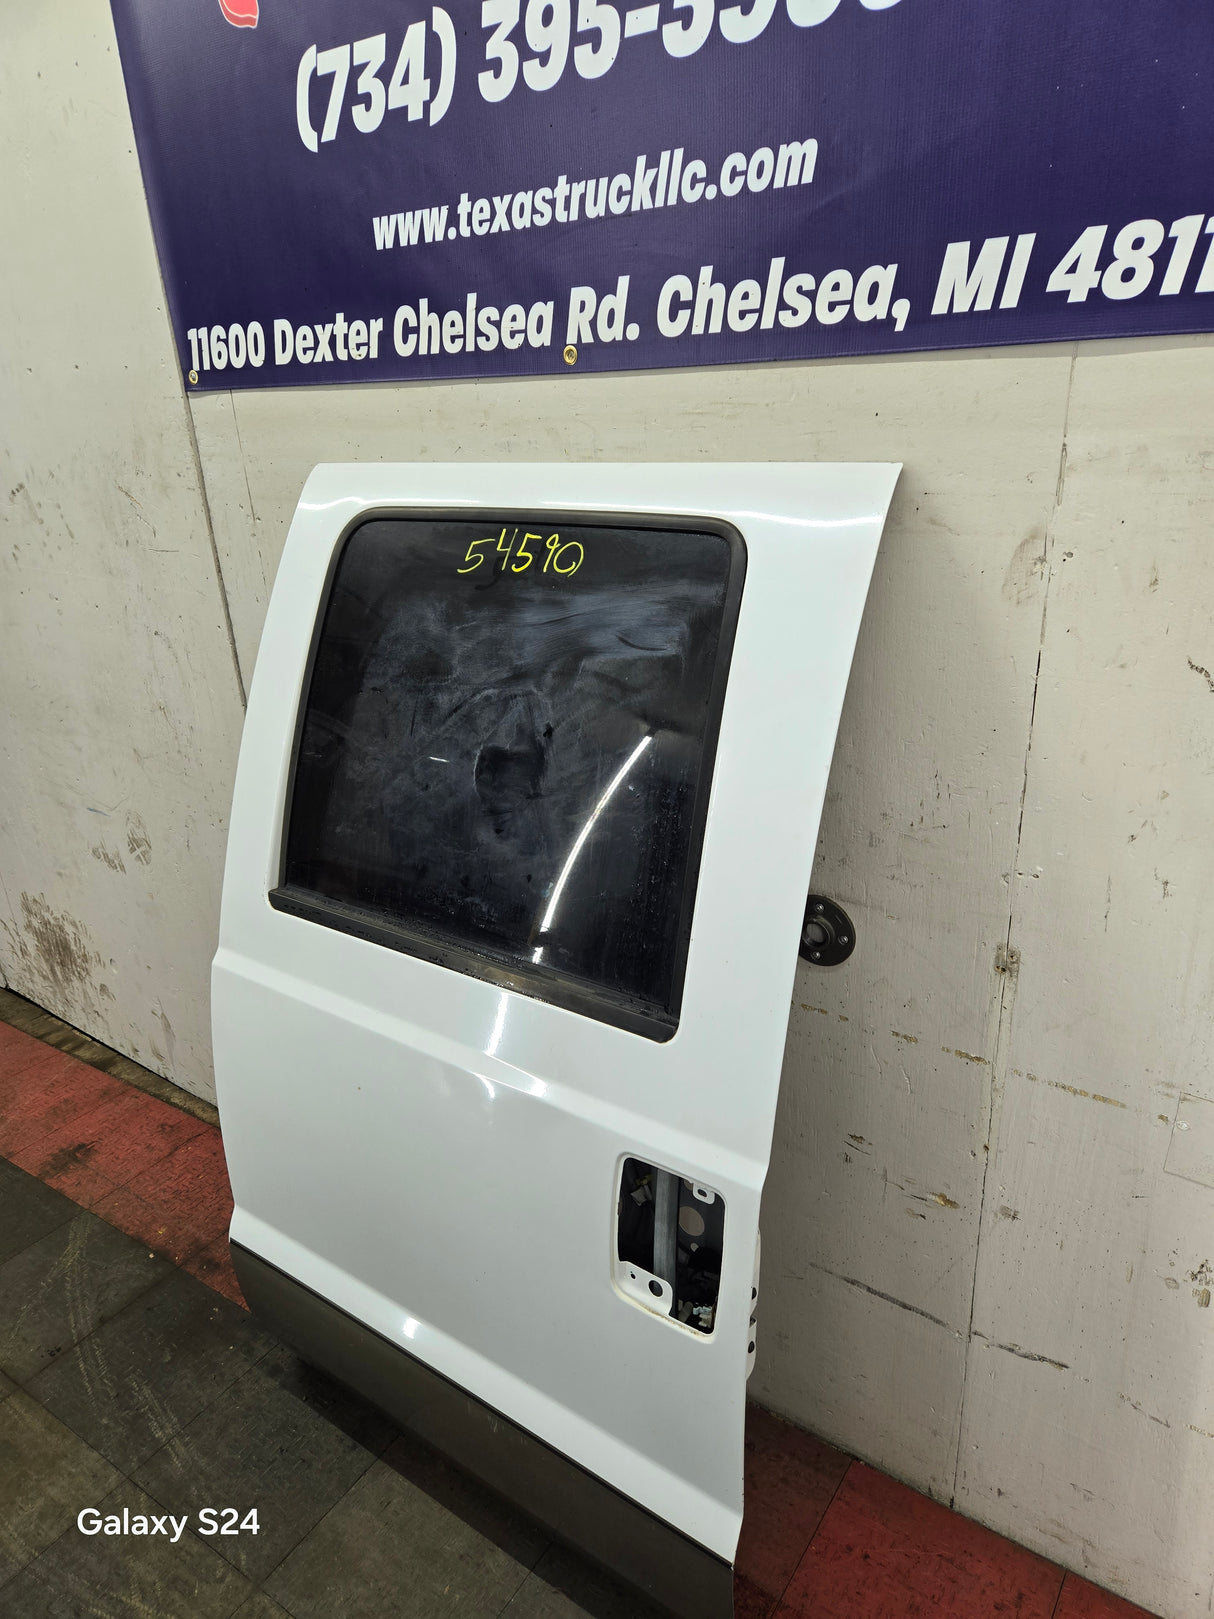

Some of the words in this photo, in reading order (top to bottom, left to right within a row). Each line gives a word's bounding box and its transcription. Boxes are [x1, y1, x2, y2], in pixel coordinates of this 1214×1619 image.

[297, 6, 457, 153] (734)
[373, 138, 818, 251] www.texastruckllc.com
[187, 321, 266, 371] 11600
[274, 312, 384, 366] Dexter
[394, 293, 555, 357] Chelsea
[565, 275, 640, 345] Rd.
[657, 257, 911, 338] Chelsea,
[931, 233, 1037, 316] MI
[457, 528, 585, 578] 54590
